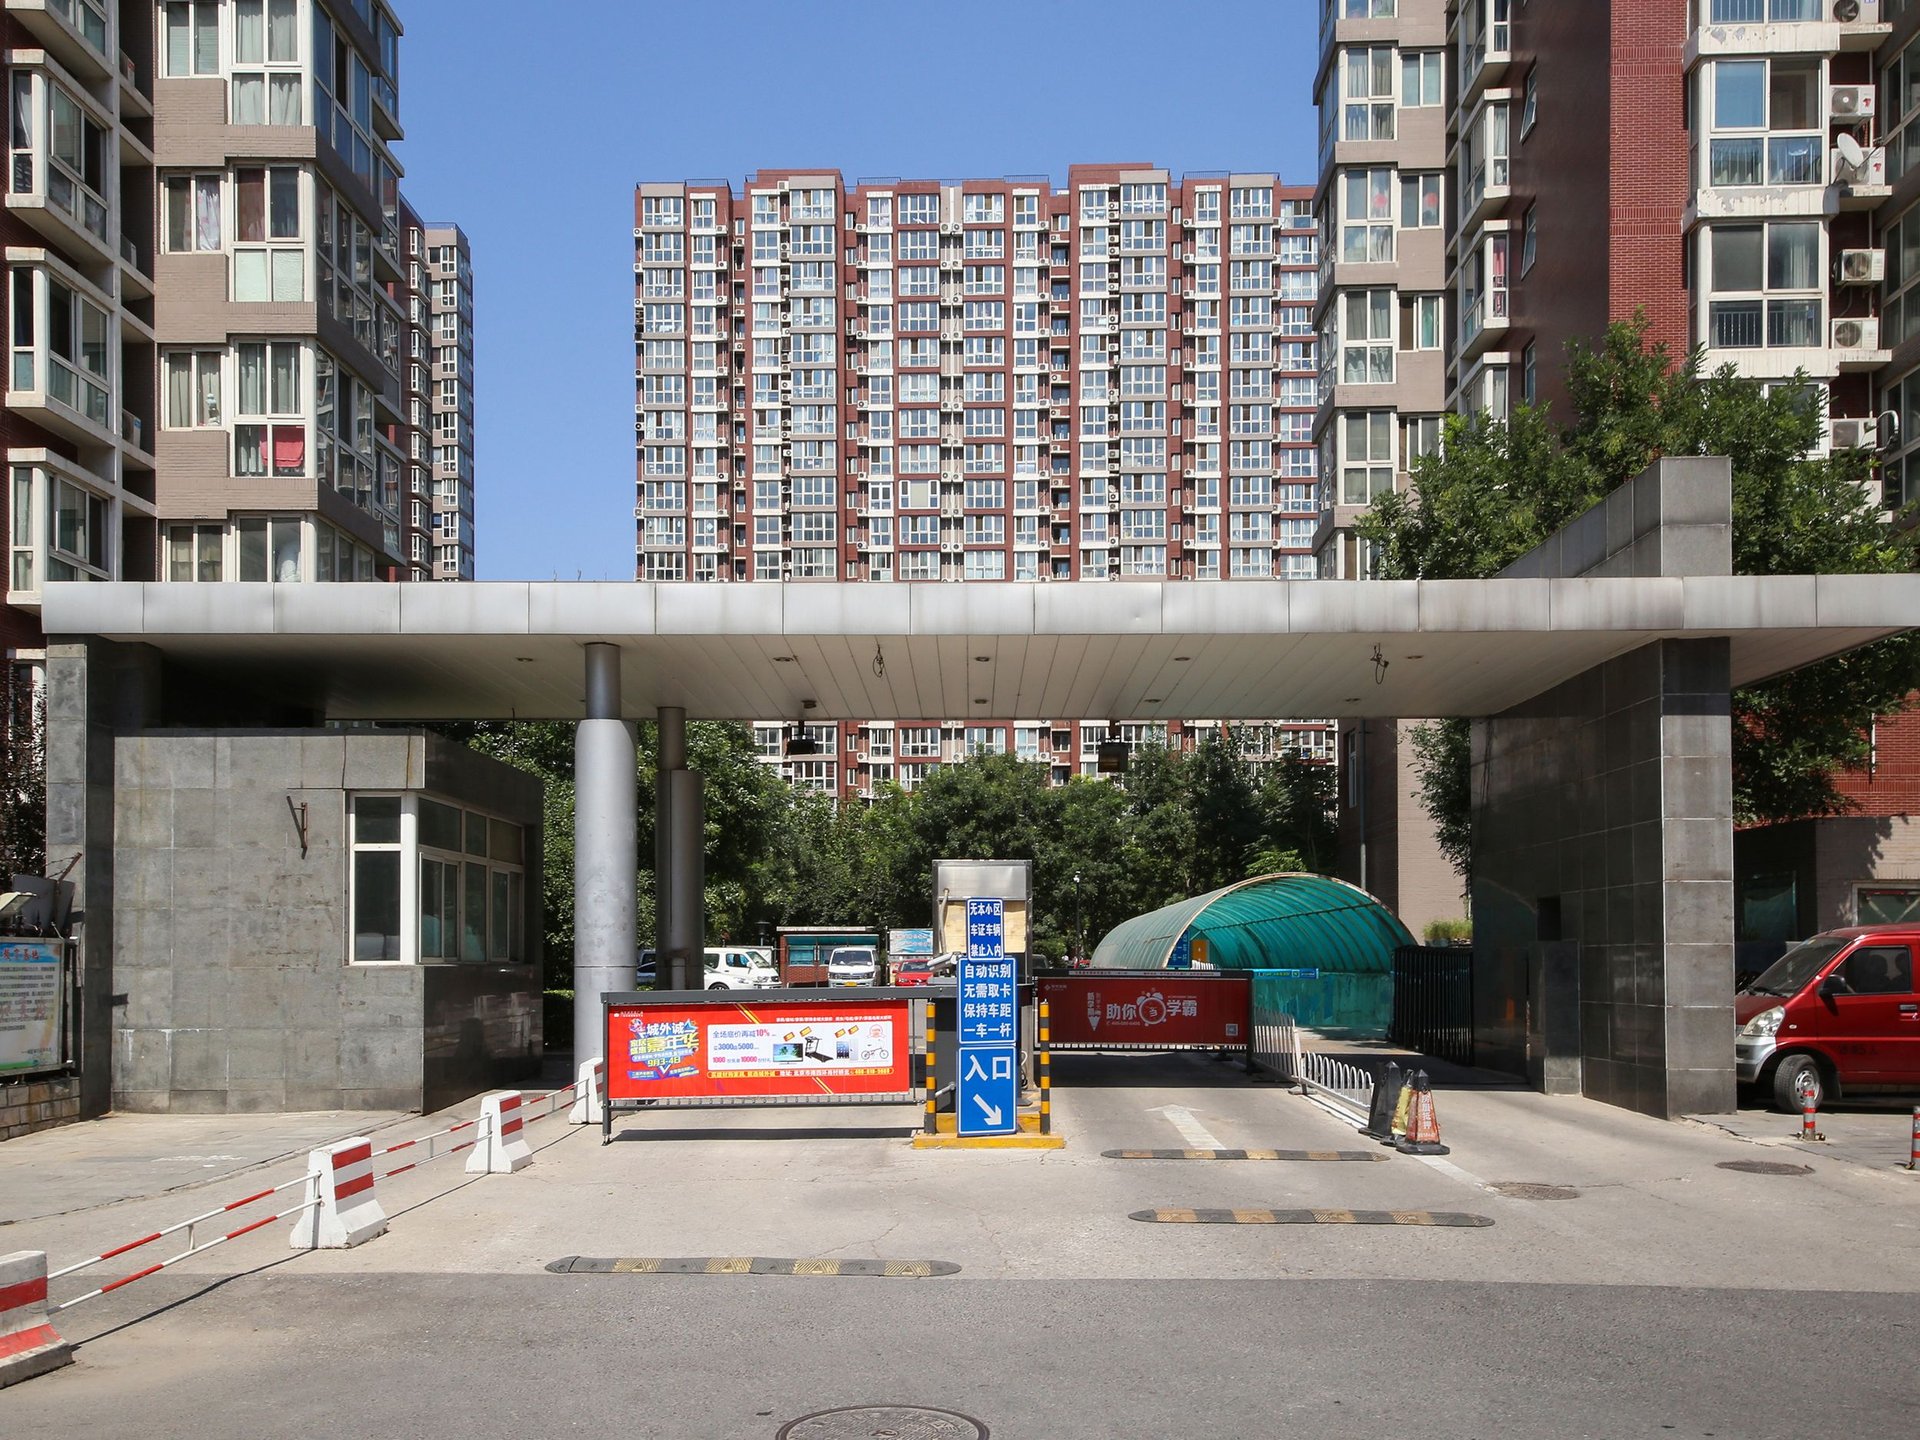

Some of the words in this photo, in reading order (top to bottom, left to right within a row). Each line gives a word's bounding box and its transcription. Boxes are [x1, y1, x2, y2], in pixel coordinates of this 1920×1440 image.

[970, 903, 1001, 917] 无本小区
[970, 923, 1001, 937] 车证车辆
[970, 943, 1002, 958] 禁止入内
[964, 964, 1011, 979] 自动识别
[964, 983, 1011, 999] 无需取卡
[964, 1003, 1011, 1018] 保持车距
[1106, 1003, 1137, 1020] 助你
[1166, 999, 1198, 1017] 学霸
[646, 1021, 685, 1036] 城外诚
[964, 1023, 1011, 1038] 一车一杆
[964, 1054, 1011, 1082] 入口
